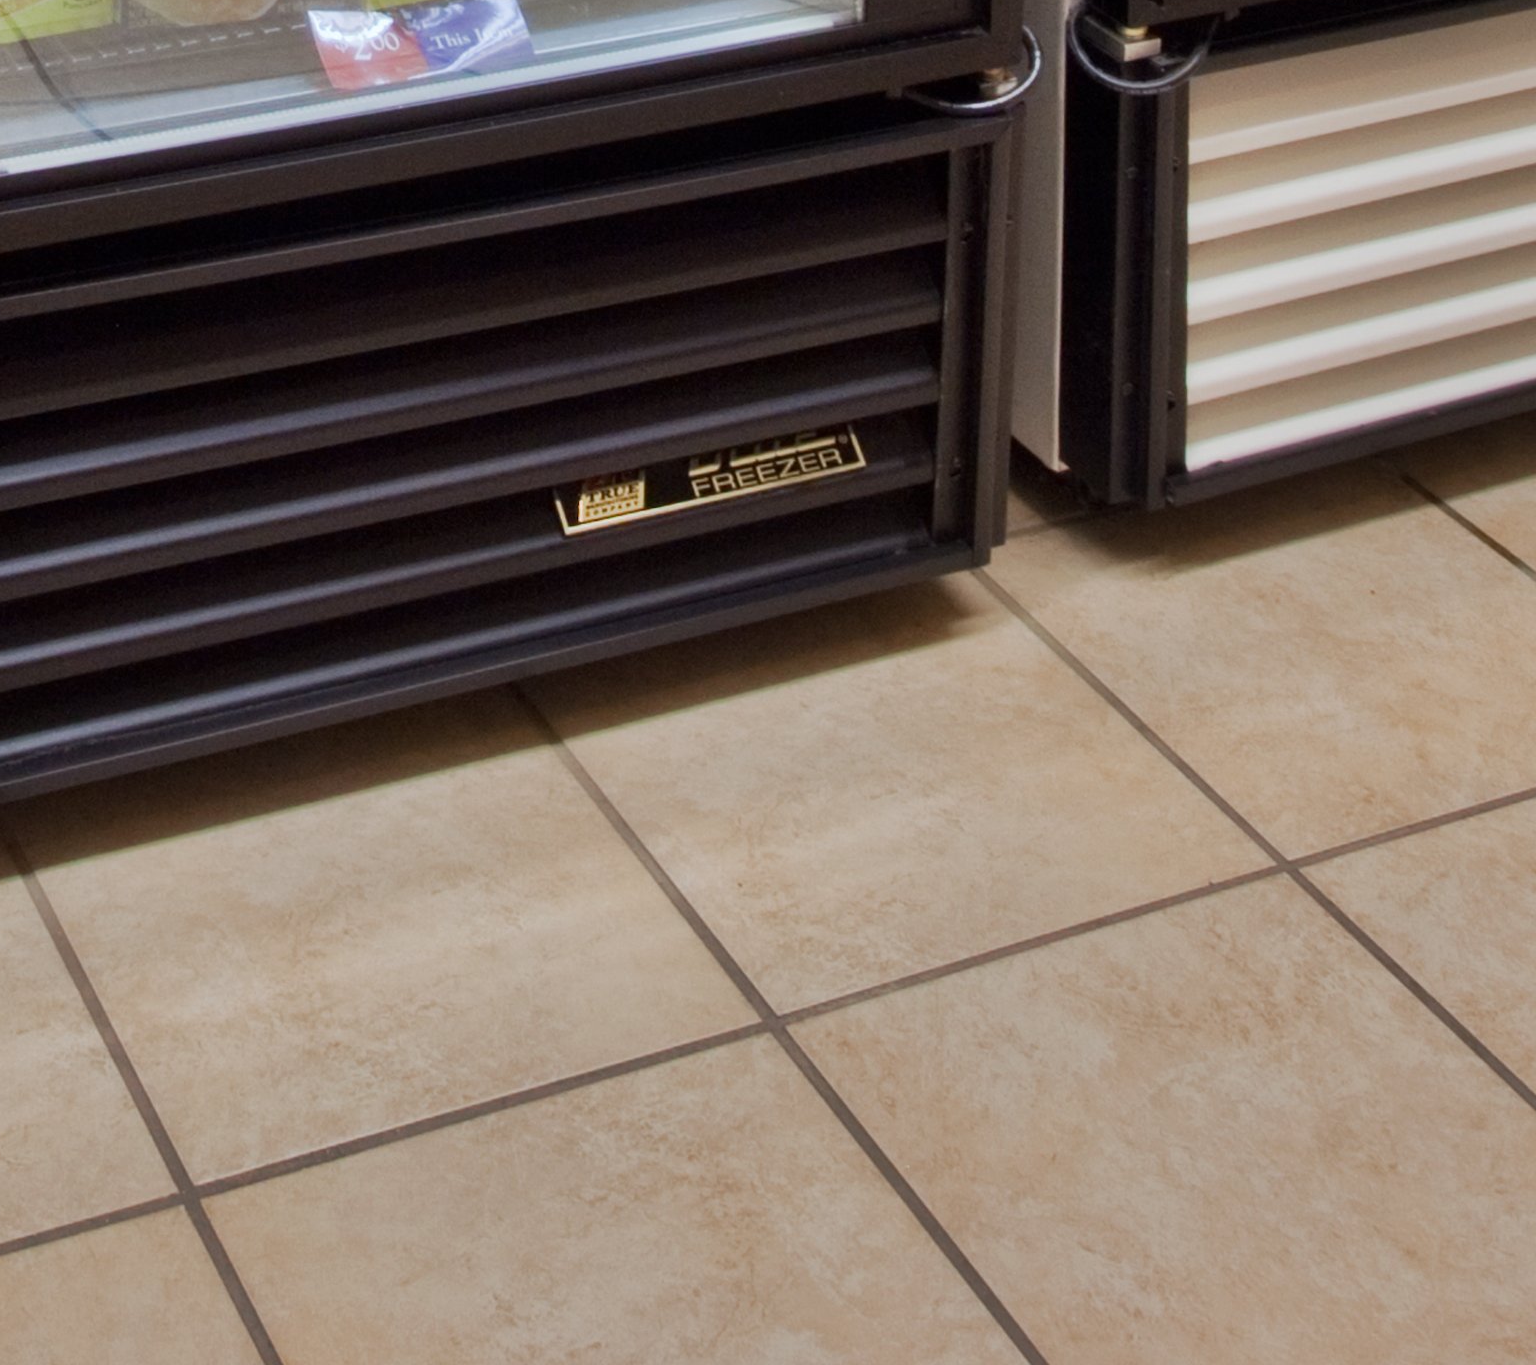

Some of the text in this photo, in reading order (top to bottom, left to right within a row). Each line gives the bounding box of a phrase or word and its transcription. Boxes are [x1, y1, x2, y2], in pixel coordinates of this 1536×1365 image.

[430, 31, 470, 50] This
[691, 448, 842, 497] FREEZER
[587, 482, 640, 502] TRUE
